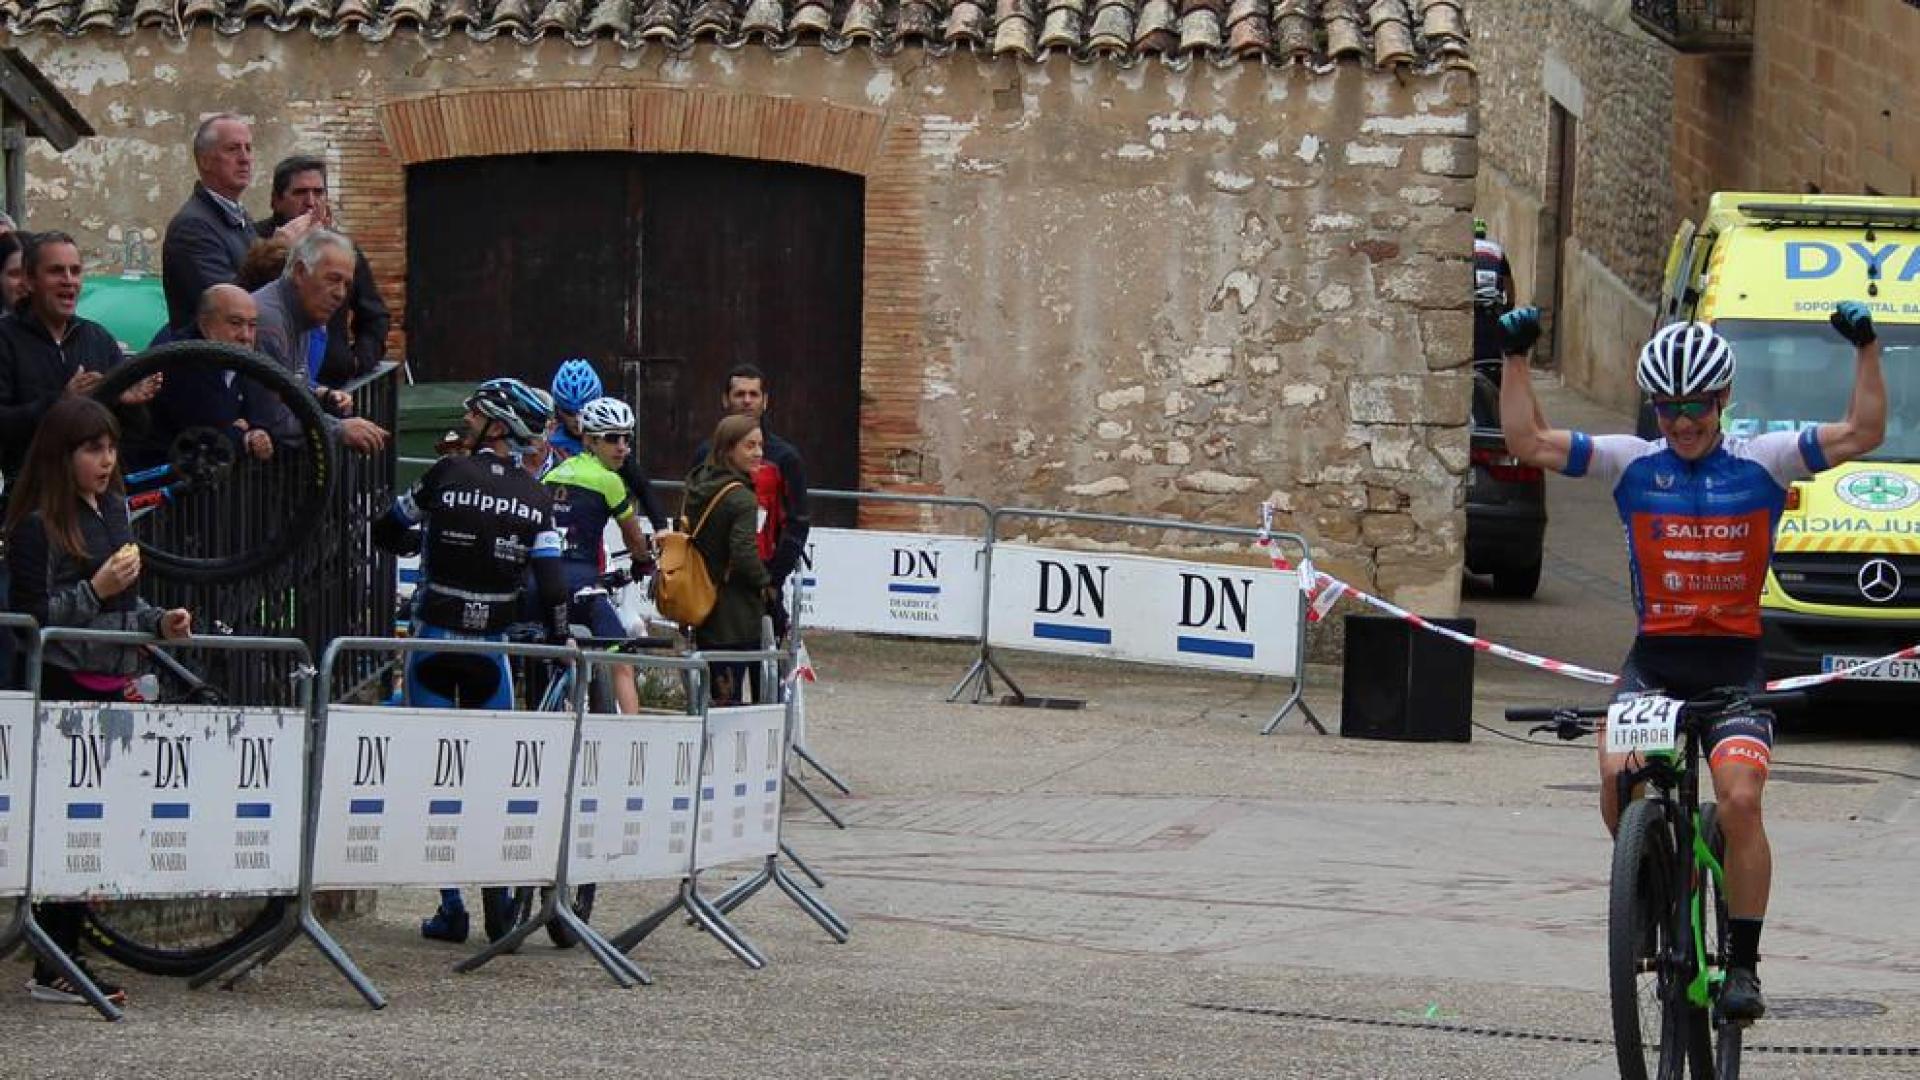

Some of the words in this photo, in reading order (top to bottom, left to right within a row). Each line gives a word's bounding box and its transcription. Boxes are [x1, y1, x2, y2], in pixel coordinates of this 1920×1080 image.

[442, 489, 542, 524] quipplan
[1666, 523, 1750, 538] SALTOKI
[892, 549, 941, 578] DN
[1036, 560, 1110, 618] DN
[1178, 573, 1253, 632] DN
[1618, 701, 1671, 724] 224
[66, 734, 105, 788] DN
[155, 736, 191, 788] DN
[238, 737, 273, 788] DN
[353, 736, 391, 786] DN
[434, 738, 469, 787] DN
[511, 740, 545, 787] DN
[581, 740, 601, 786] DN
[628, 740, 648, 786] DN
[675, 741, 694, 786] DN
